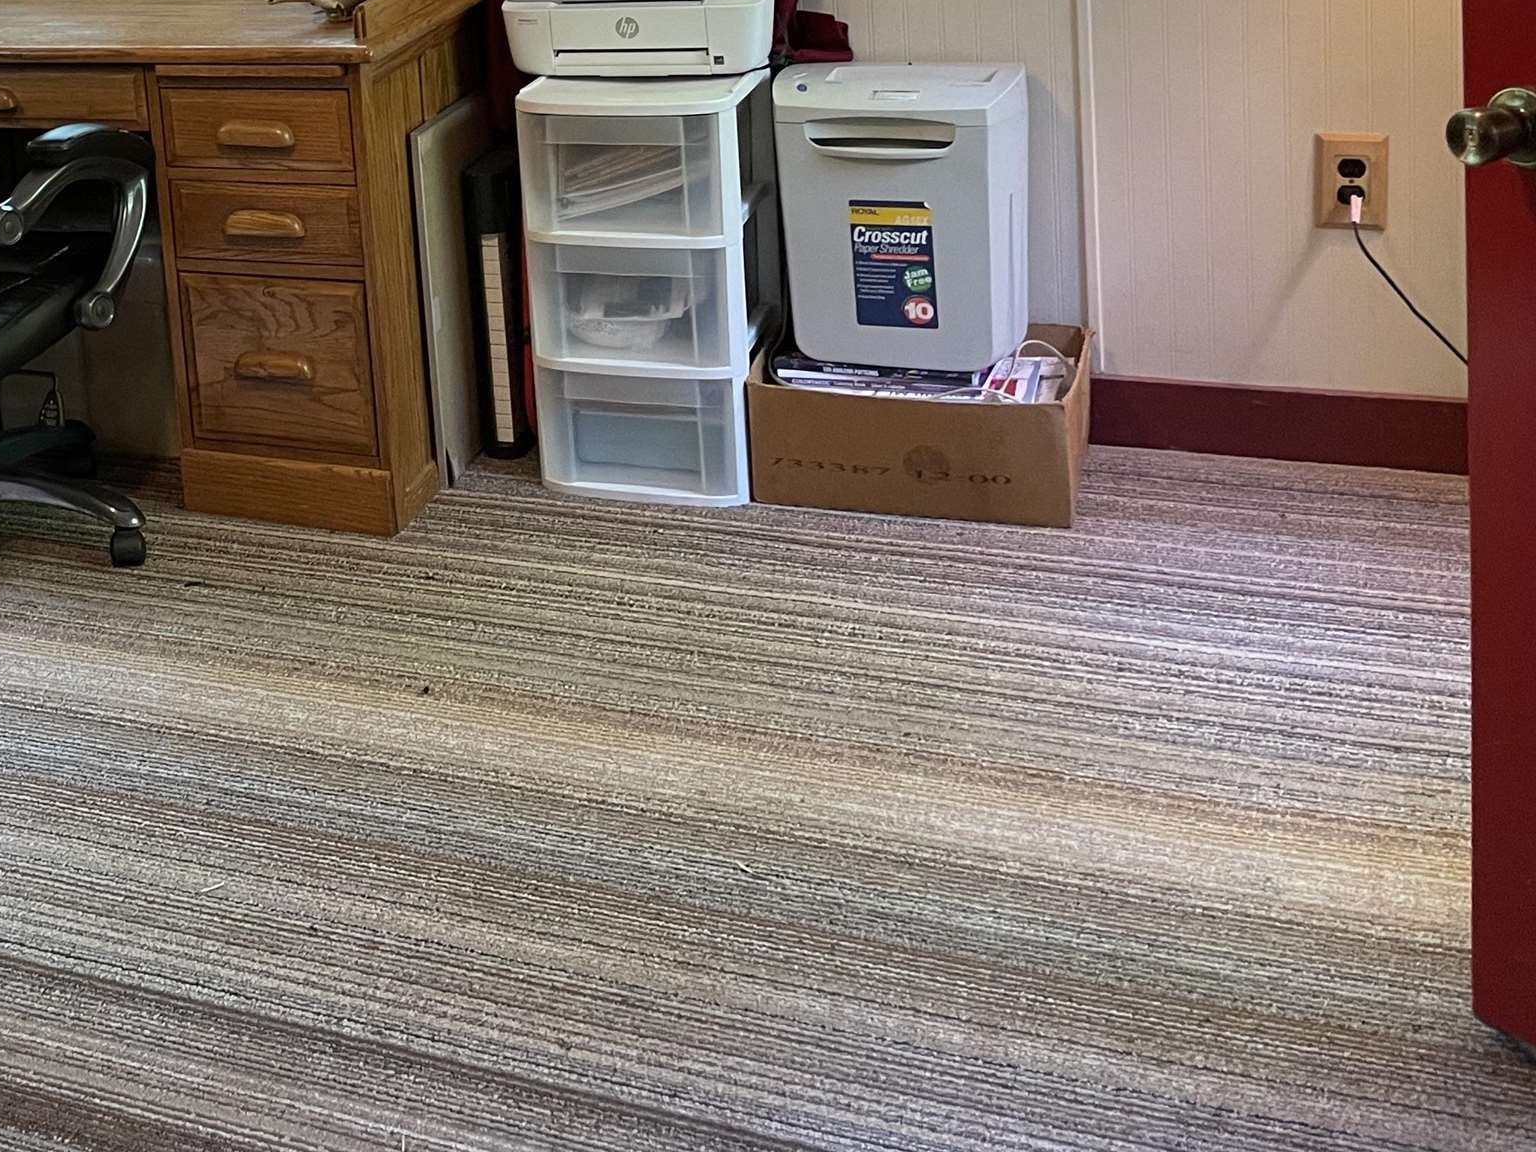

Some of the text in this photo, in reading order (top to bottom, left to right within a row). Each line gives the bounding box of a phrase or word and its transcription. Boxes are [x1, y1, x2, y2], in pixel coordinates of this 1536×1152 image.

[617, 16, 638, 39] hp
[853, 225, 929, 245] Crosscut
[854, 242, 920, 256] Paper Shredder
[904, 268, 929, 280] Jam
[906, 276, 933, 288] Free
[904, 301, 935, 321] 10
